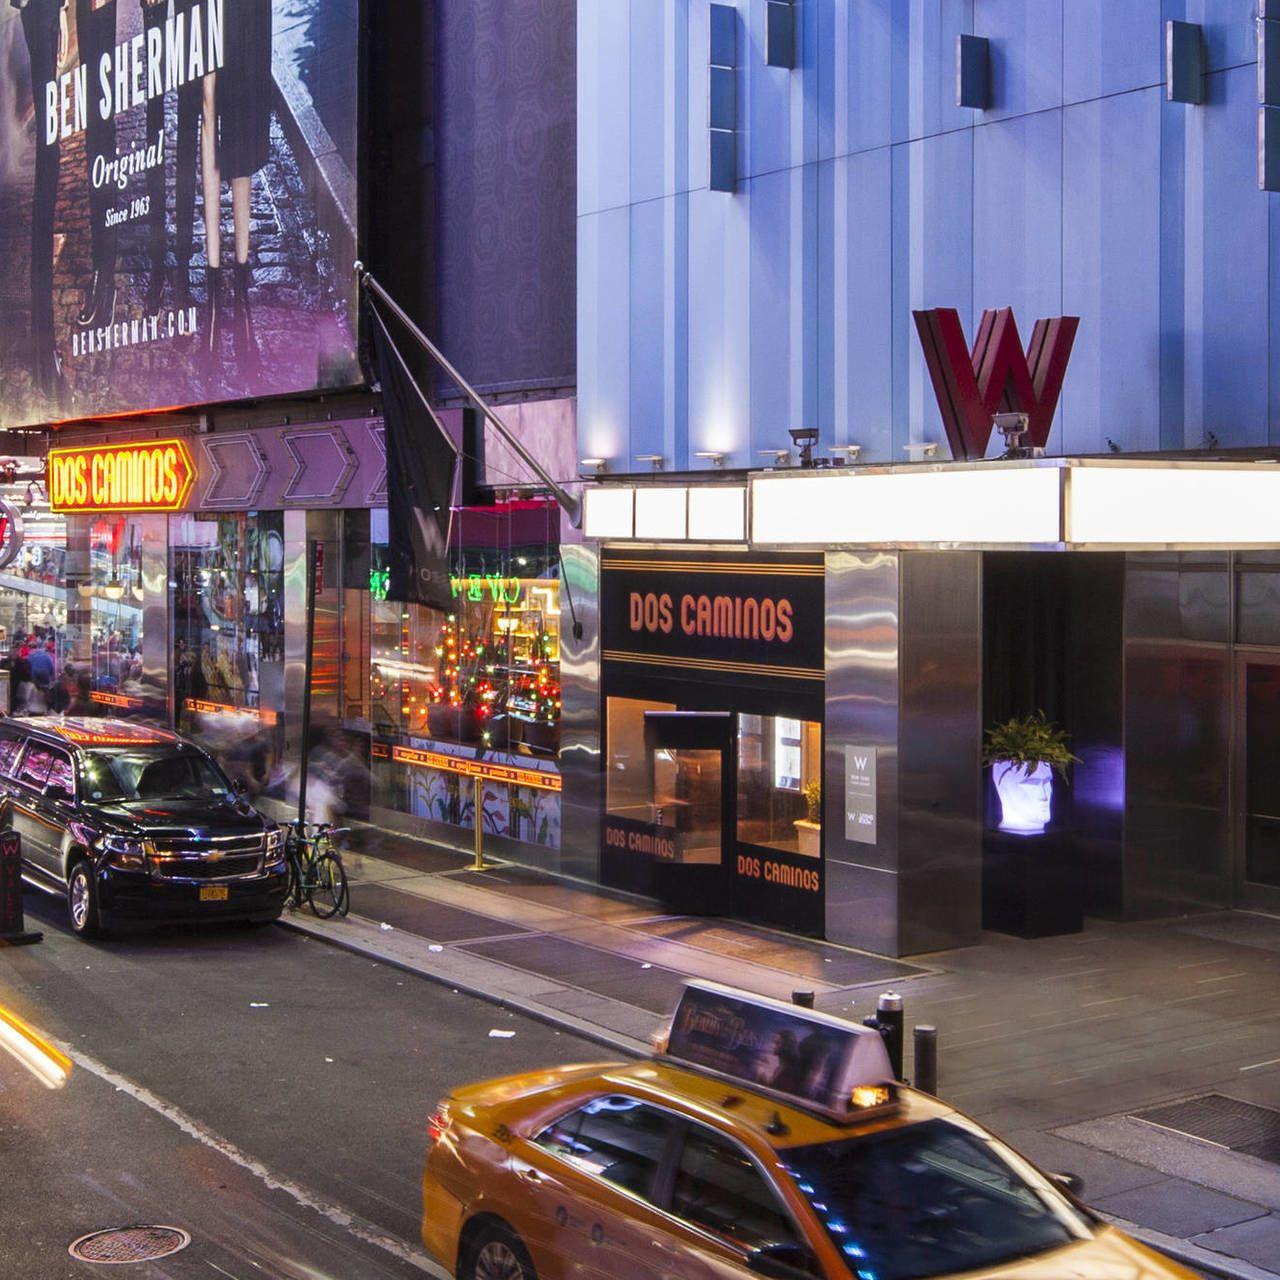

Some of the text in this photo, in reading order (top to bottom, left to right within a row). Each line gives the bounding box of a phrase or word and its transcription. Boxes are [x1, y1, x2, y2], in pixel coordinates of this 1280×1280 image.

[45, 64, 87, 146] BEN
[91, 130, 163, 189] Original
[105, 195, 150, 228] Since 1963
[72, 307, 198, 357] BENSHERMAN.COM
[912, 306, 1080, 462] W
[53, 448, 177, 505] DOS CAMINOS
[629, 592, 794, 643] DOS CAMINOS
[854, 756, 867, 770] W
[606, 826, 674, 858] DOS CAMINOS
[737, 856, 819, 892] DOS CAMINOS
